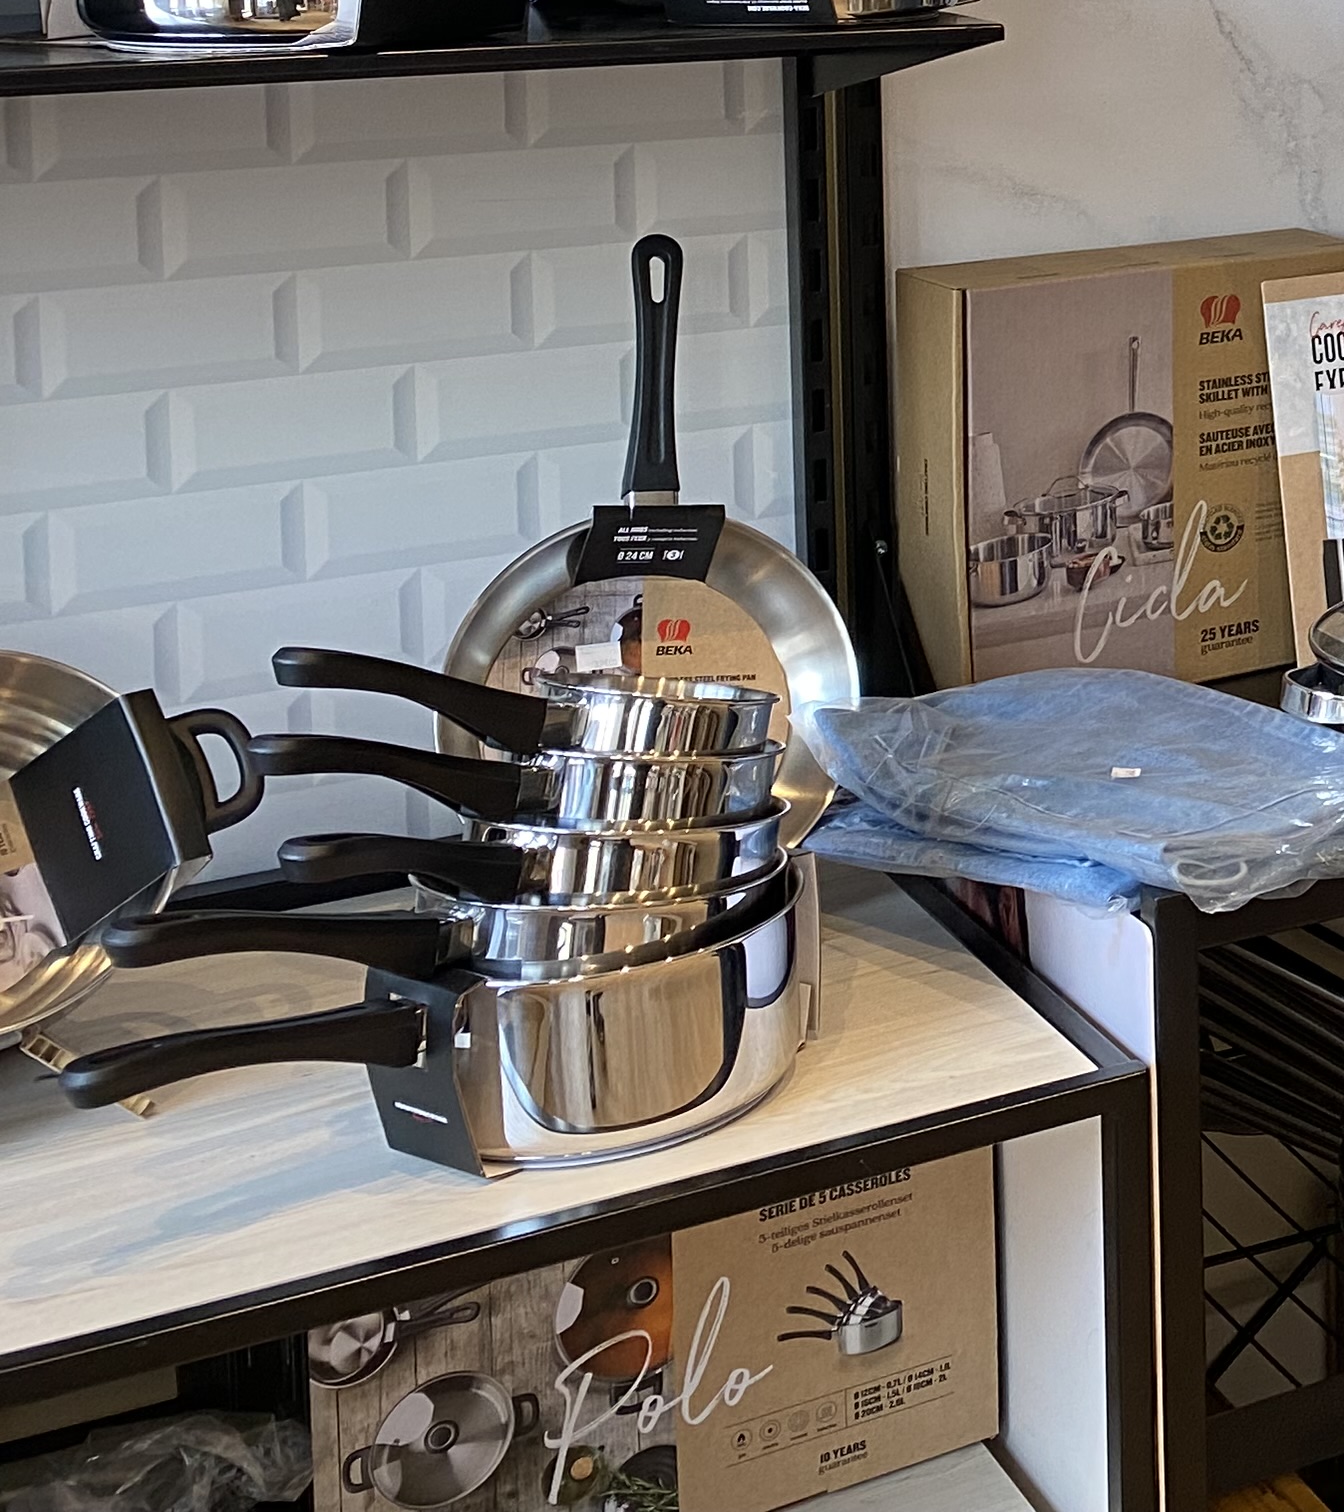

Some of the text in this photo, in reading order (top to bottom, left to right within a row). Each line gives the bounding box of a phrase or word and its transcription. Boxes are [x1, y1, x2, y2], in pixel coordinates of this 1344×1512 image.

[1199, 328, 1244, 346] BEKA
[1199, 374, 1253, 392] STAINLESS
[1199, 384, 1268, 404] SKILLET WITH
[1199, 402, 1254, 421] High-quality
[1199, 426, 1251, 445] SAUTEUSE
[1199, 444, 1213, 457] EN
[1214, 440, 1244, 456] ACIER
[624, 551, 638, 560] 24
[638, 550, 654, 560] CM
[1200, 619, 1260, 643] 25 YEARS
[656, 645, 693, 656] BEKA
[1200, 636, 1254, 656] guarantee
[716, 674, 741, 682] FRYING
[798, 1193, 816, 1210] DE
[818, 1190, 827, 1205] 5
[828, 1168, 912, 1201] CASSEROLES
[772, 1208, 902, 1254] 5-delige sauspannenset
[544, 1276, 774, 1505] Polo
[860, 1384, 880, 1398] 12CM
[914, 1368, 934, 1381] 14CM
[861, 1404, 884, 1418] 20CM
[820, 1440, 866, 1464] 10 YEARS
